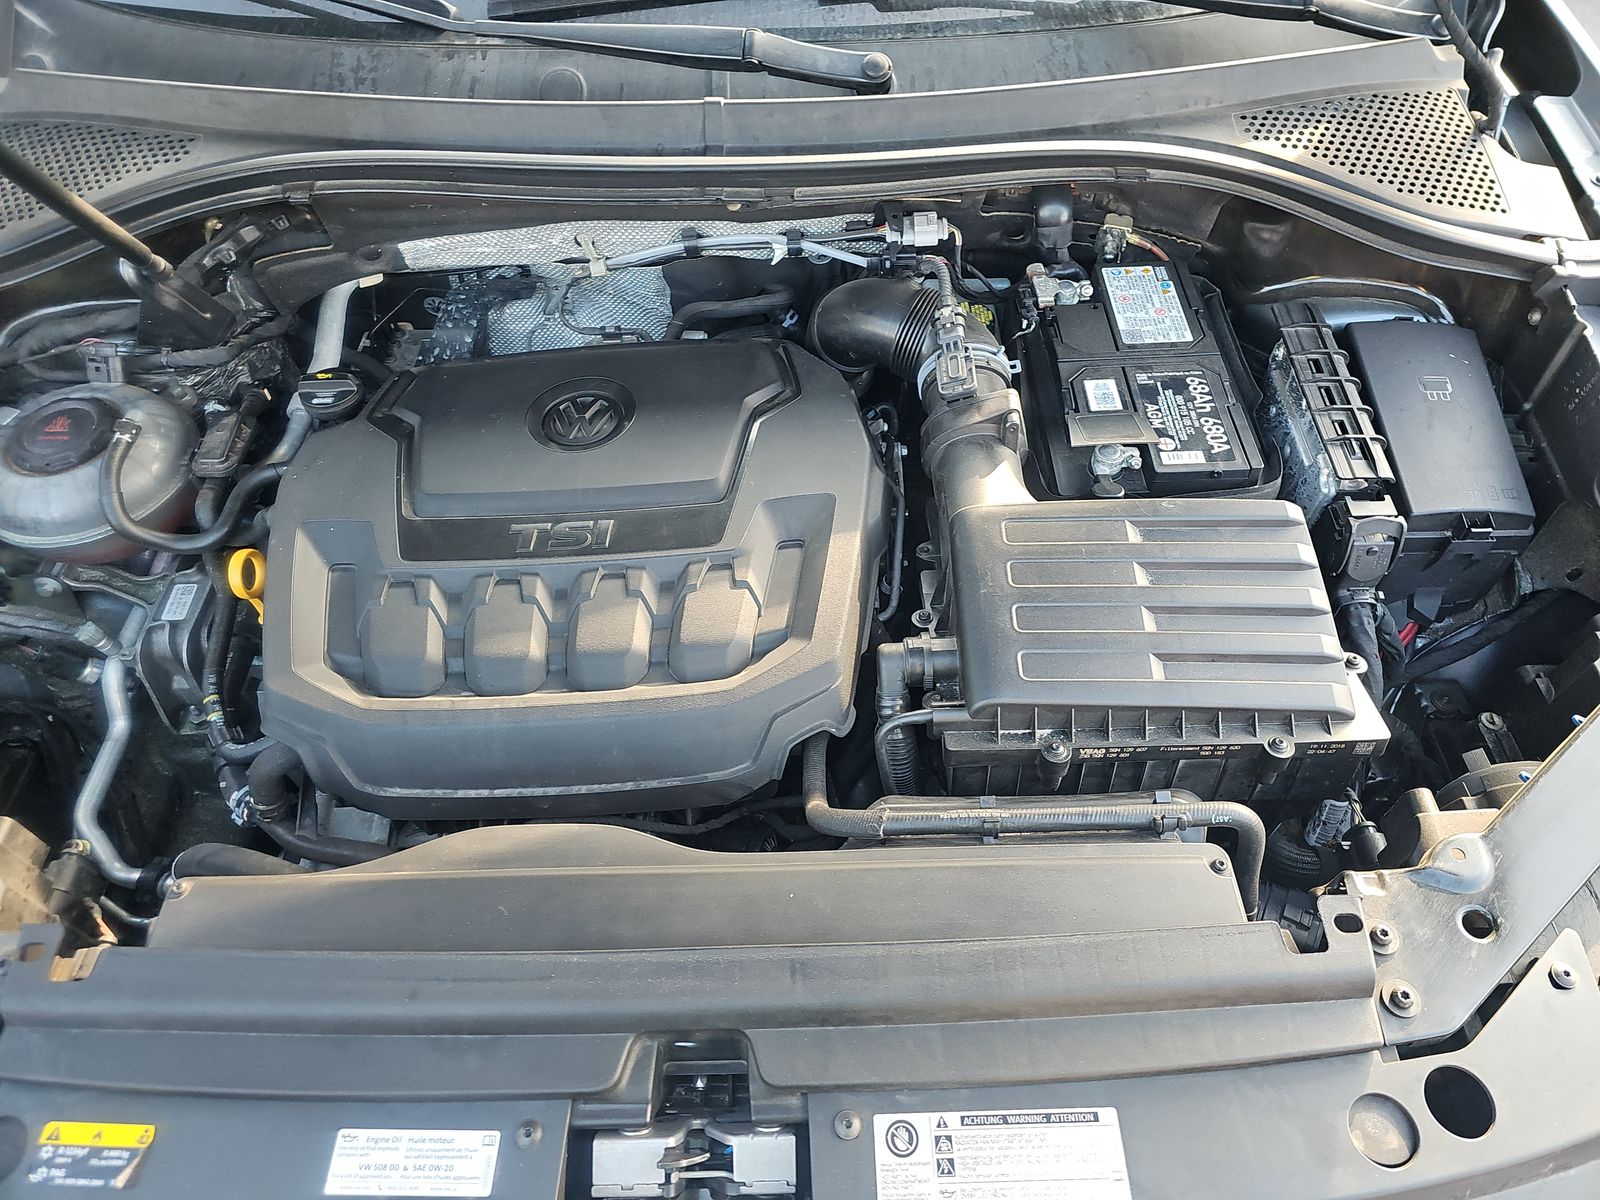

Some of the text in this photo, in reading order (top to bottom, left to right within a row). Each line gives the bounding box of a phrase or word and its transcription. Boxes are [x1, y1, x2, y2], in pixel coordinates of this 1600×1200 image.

[1143, 403, 1166, 429] AGM
[1185, 376, 1231, 454] 68Ah 680A
[508, 519, 615, 553] TSI
[962, 1112, 1095, 1126] ACHTUNG WARNING ATTENTION
[366, 1135, 403, 1145] Engine Oil
[408, 1135, 455, 1144] Huile moteur
[358, 1163, 373, 1171] VW
[373, 1163, 388, 1171] 508
[388, 1163, 400, 1171] 00
[412, 1164, 427, 1172] SAE
[428, 1164, 454, 1172] 0W-20
